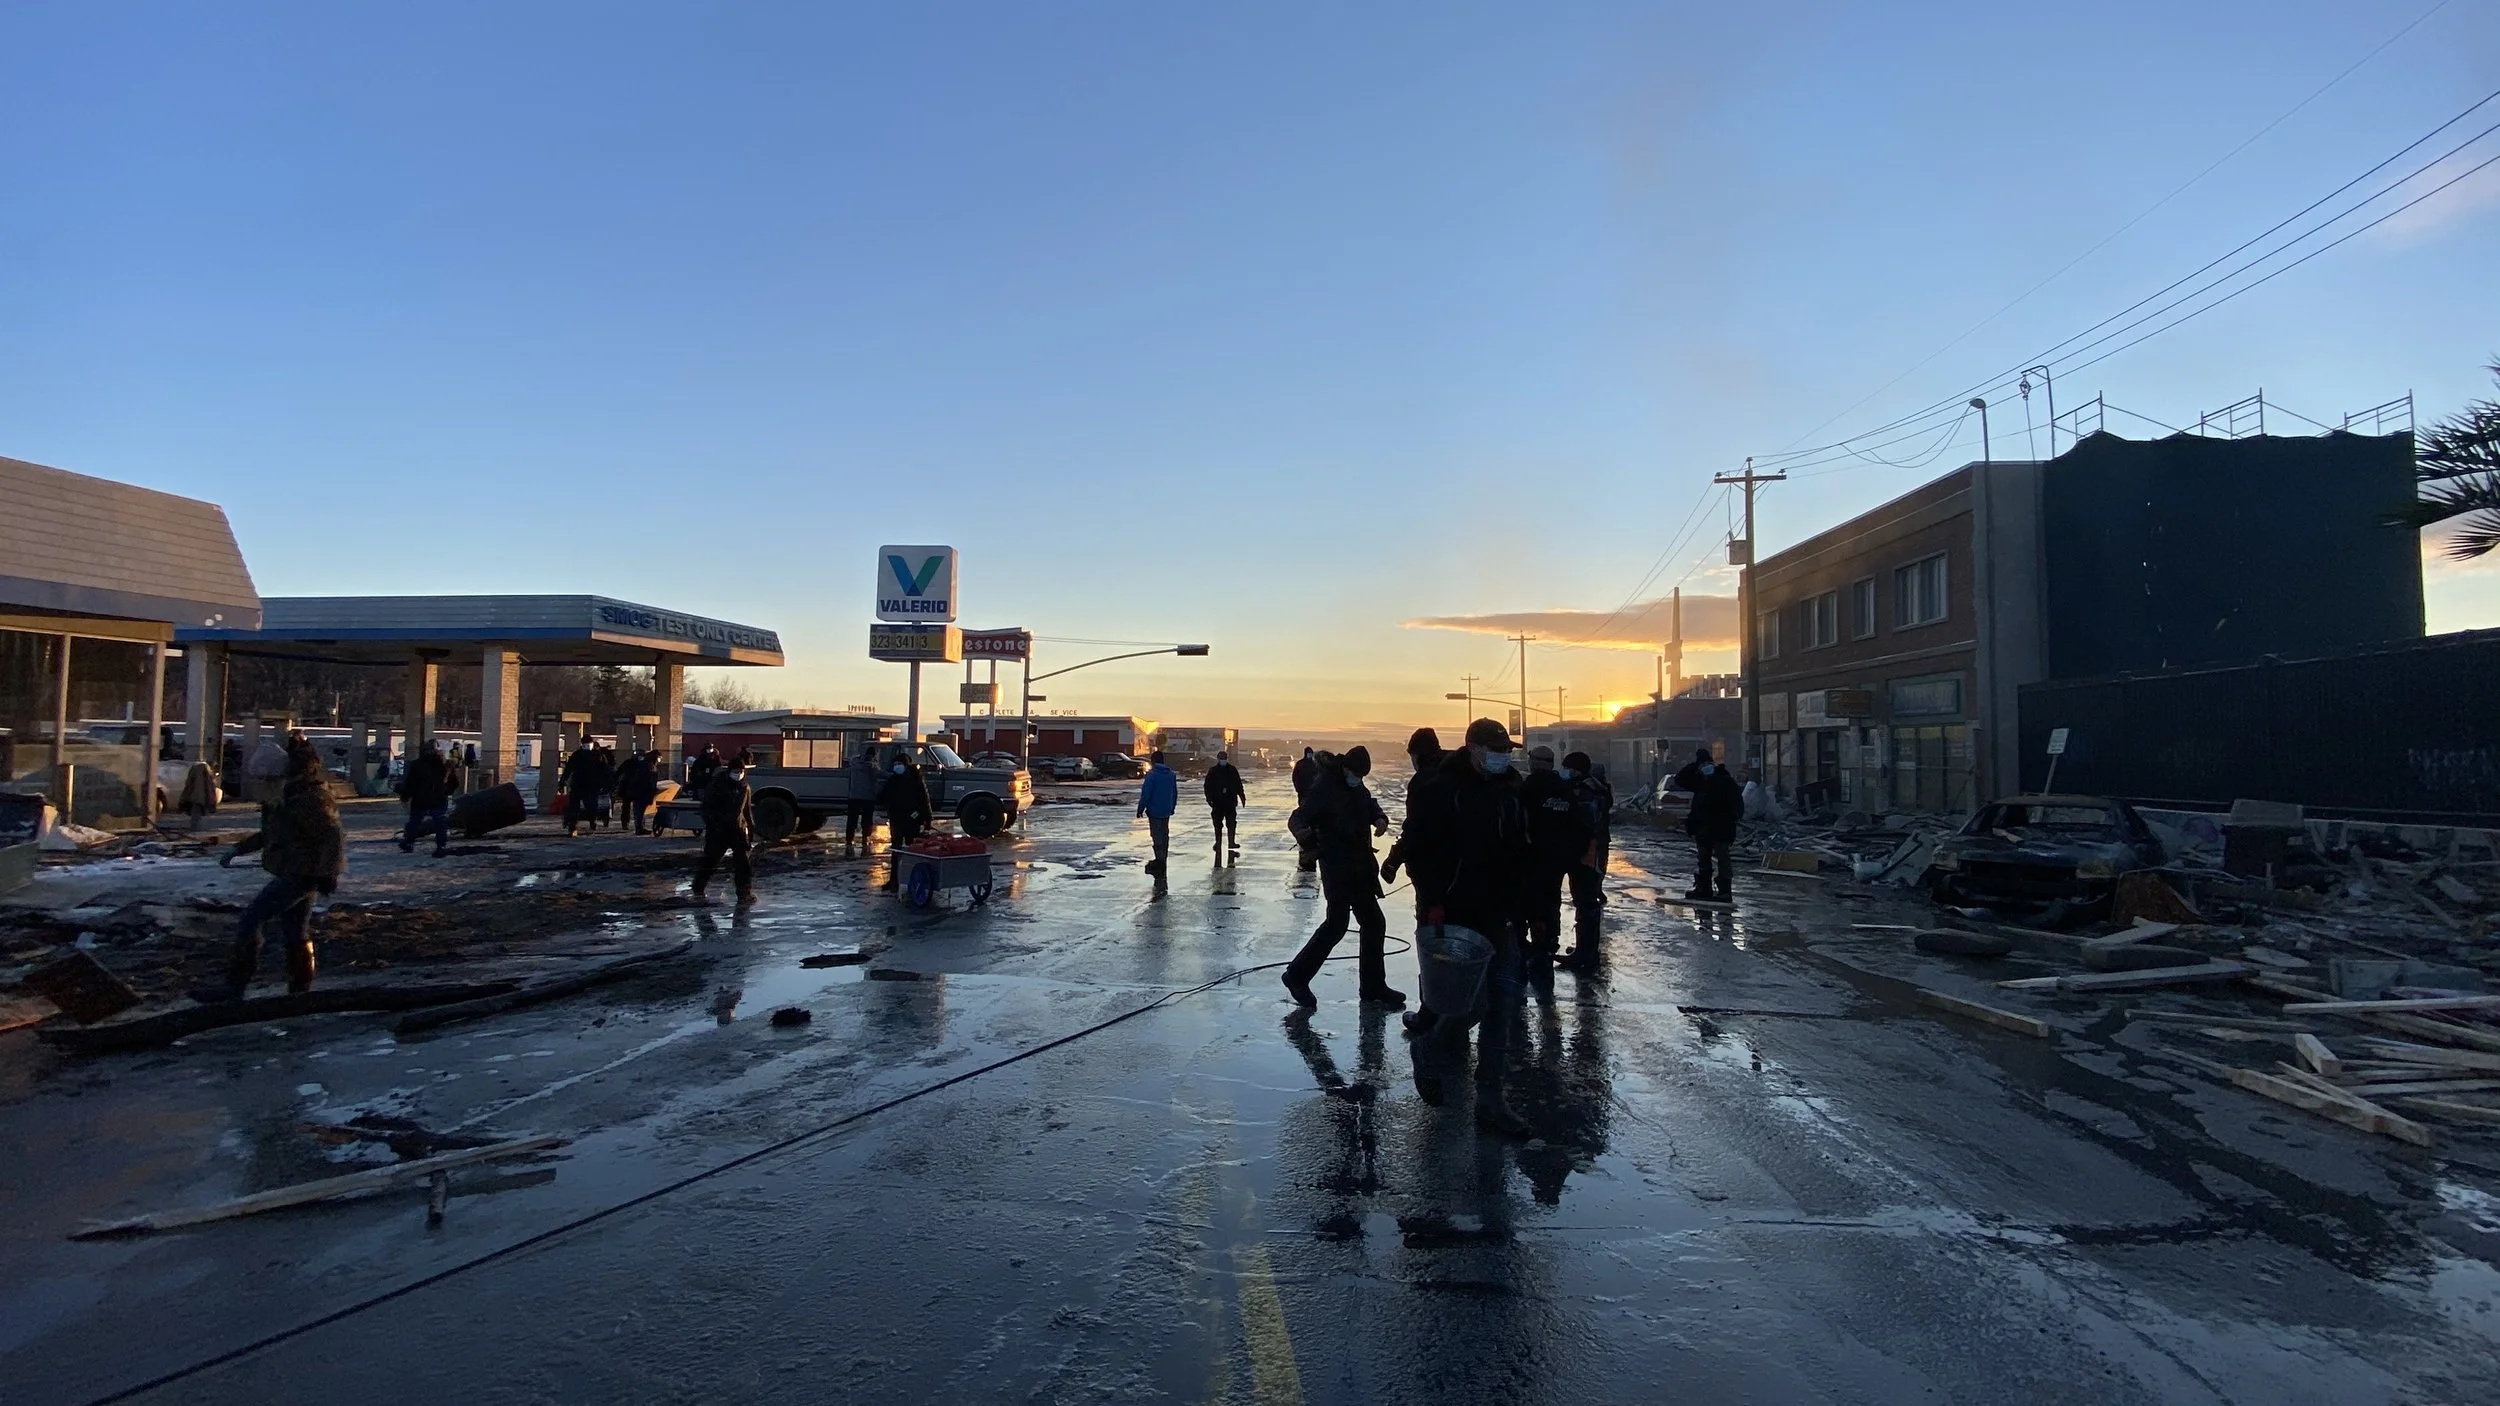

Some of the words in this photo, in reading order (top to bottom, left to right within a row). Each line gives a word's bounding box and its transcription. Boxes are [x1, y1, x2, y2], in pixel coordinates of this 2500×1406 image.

[880, 600, 948, 613] VALERIO
[655, 616, 694, 639] TEST
[698, 622, 732, 643] ONLY
[733, 628, 779, 650] CENTER
